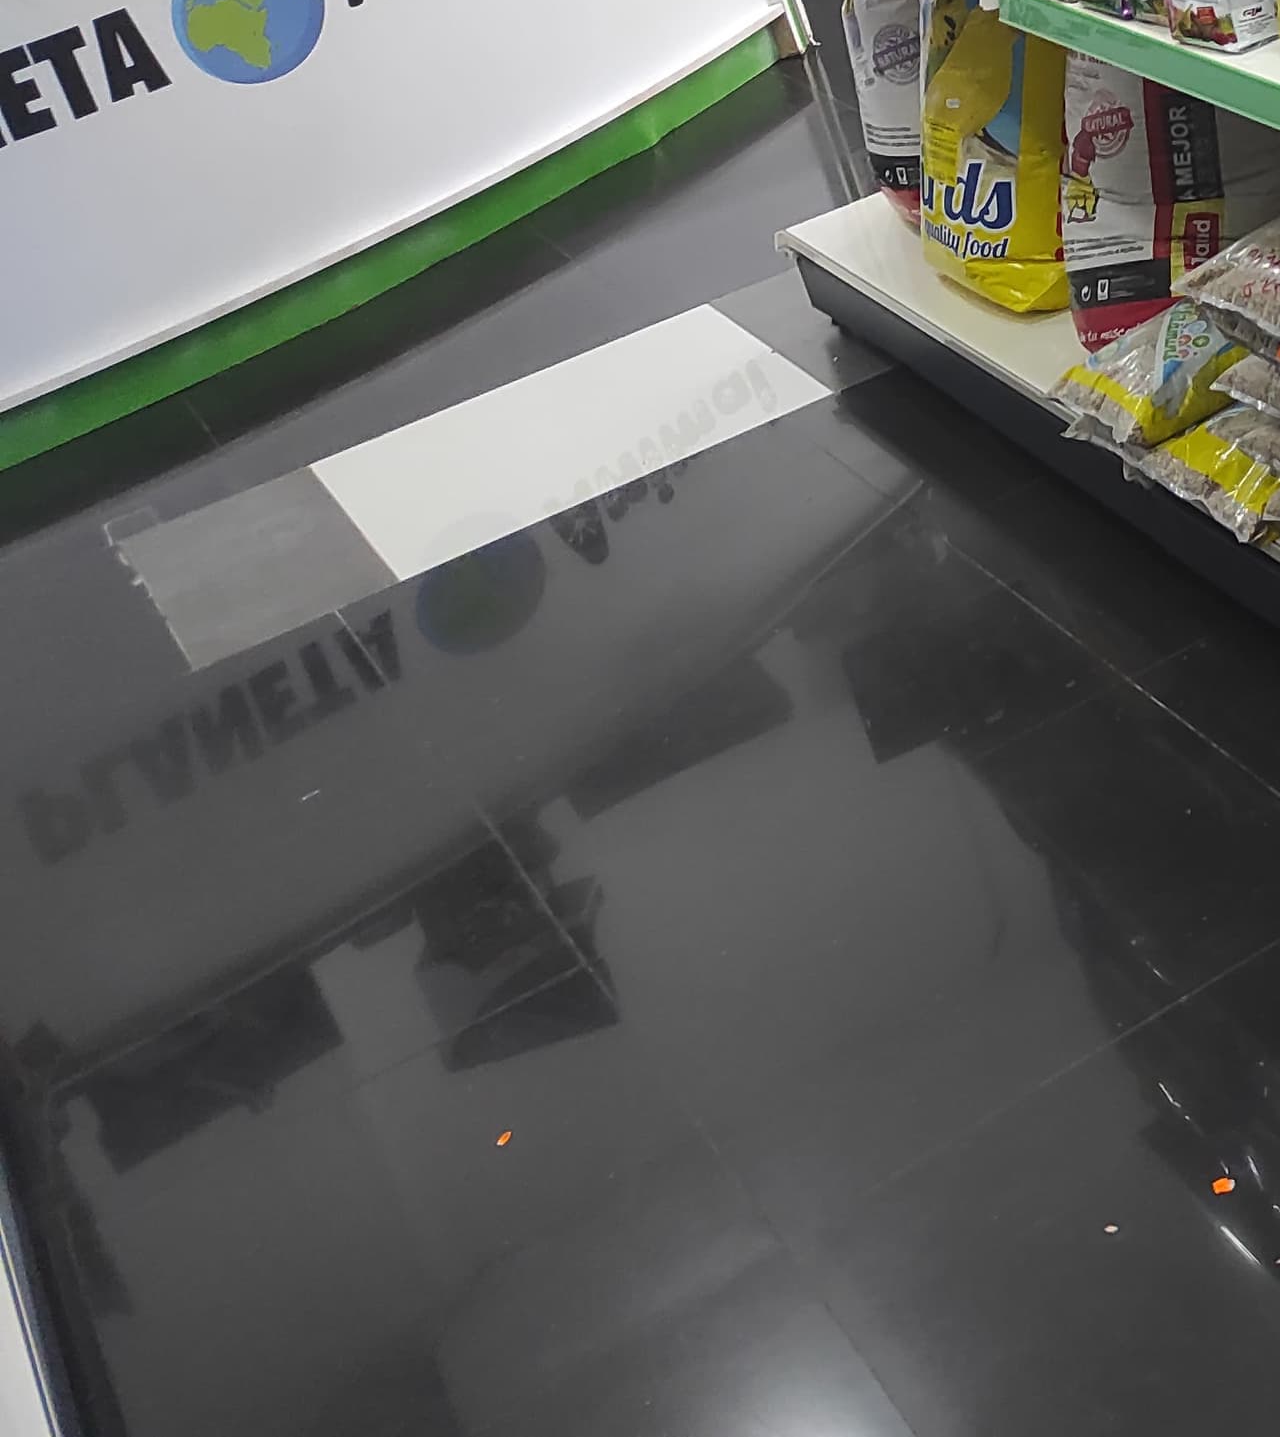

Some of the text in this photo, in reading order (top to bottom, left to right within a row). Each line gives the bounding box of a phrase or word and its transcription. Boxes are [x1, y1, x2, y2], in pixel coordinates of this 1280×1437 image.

[0, 8, 172, 149] ETA
[1168, 104, 1195, 186] MEJOR
[962, 230, 1010, 260] food
